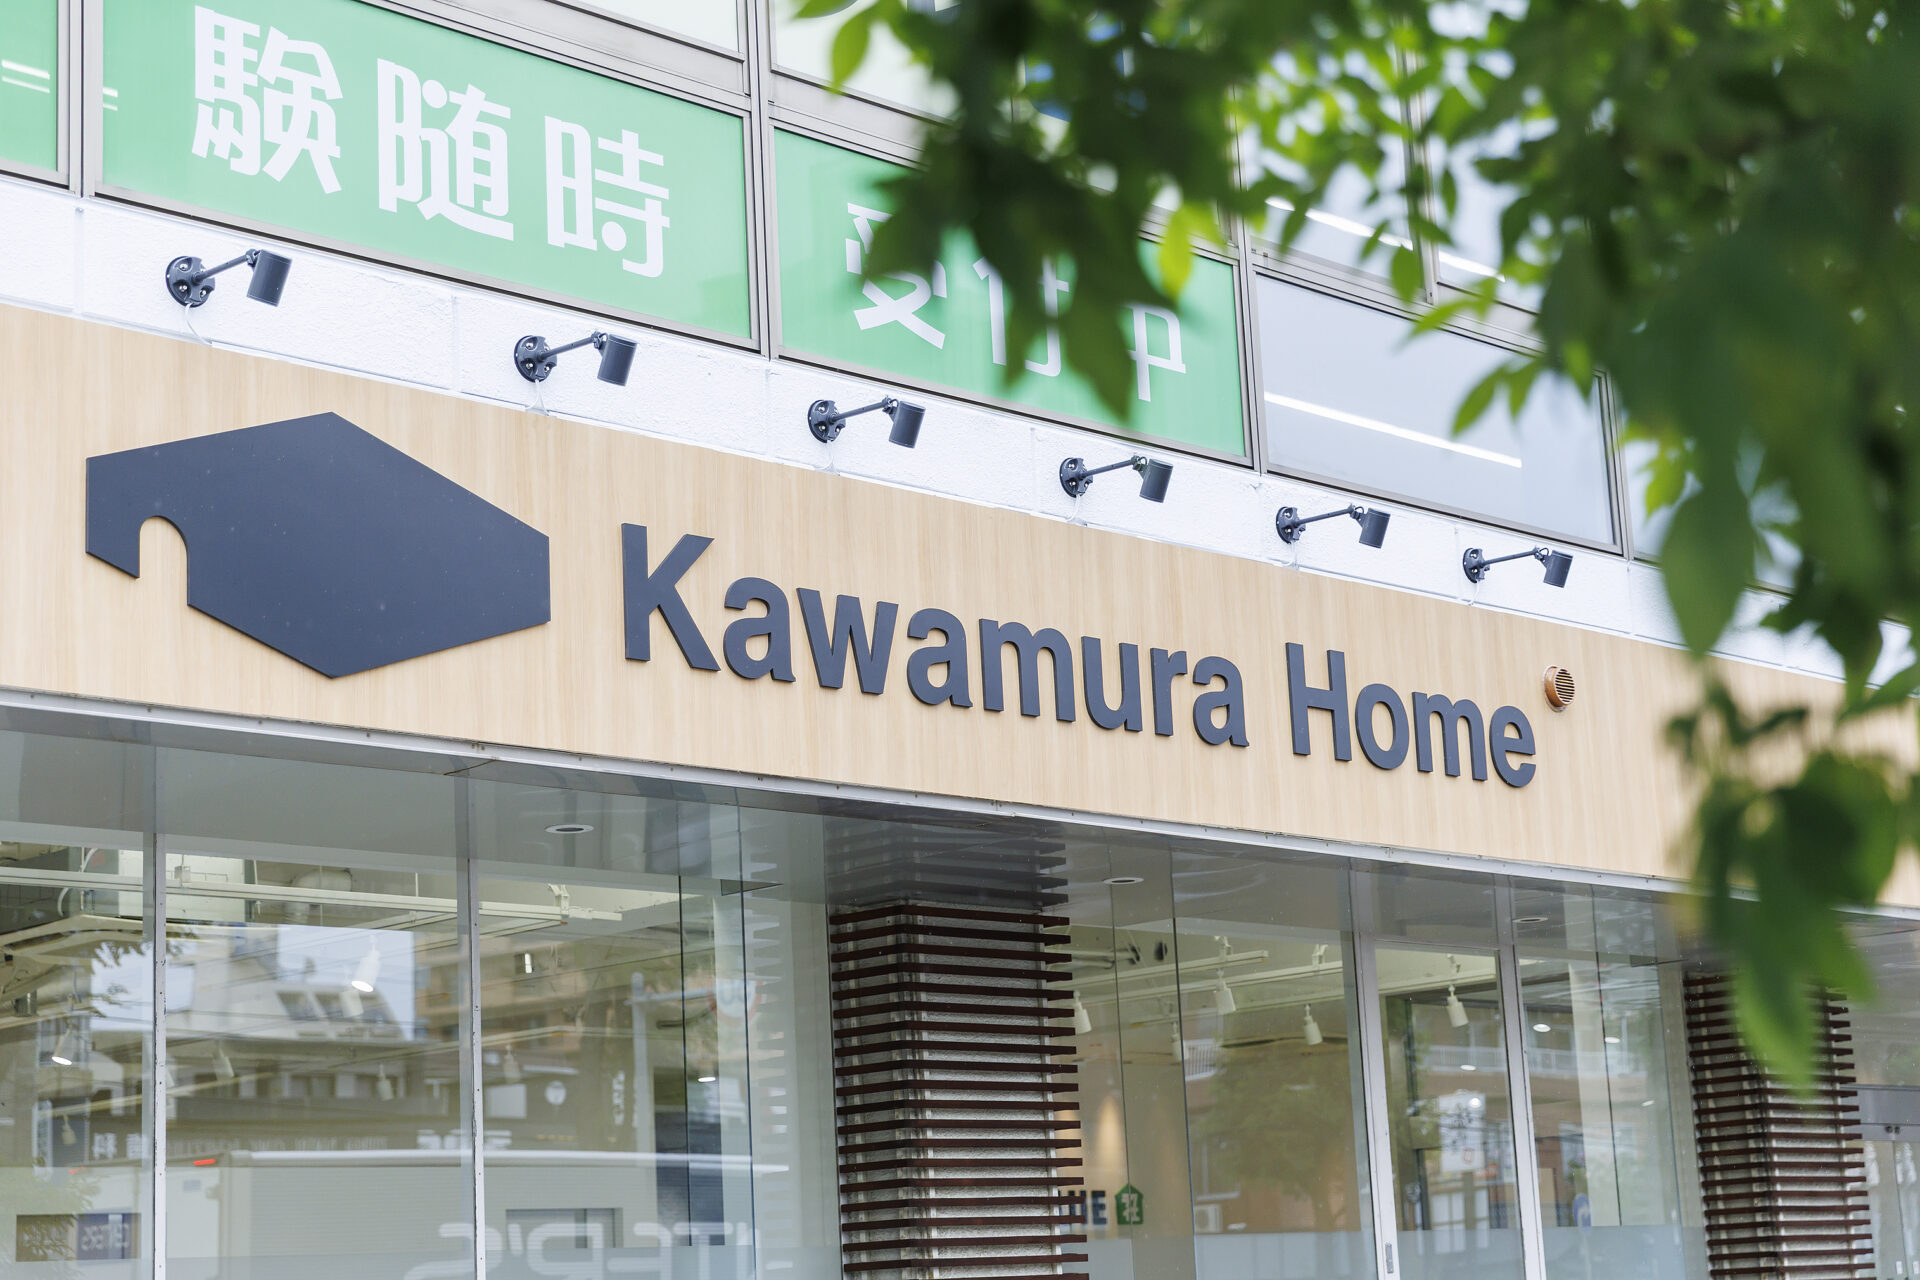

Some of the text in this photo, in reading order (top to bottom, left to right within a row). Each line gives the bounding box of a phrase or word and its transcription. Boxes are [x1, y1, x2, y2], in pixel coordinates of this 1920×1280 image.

[191, 4, 670, 278] 験随時
[621, 523, 1536, 788] Kawamura Home
